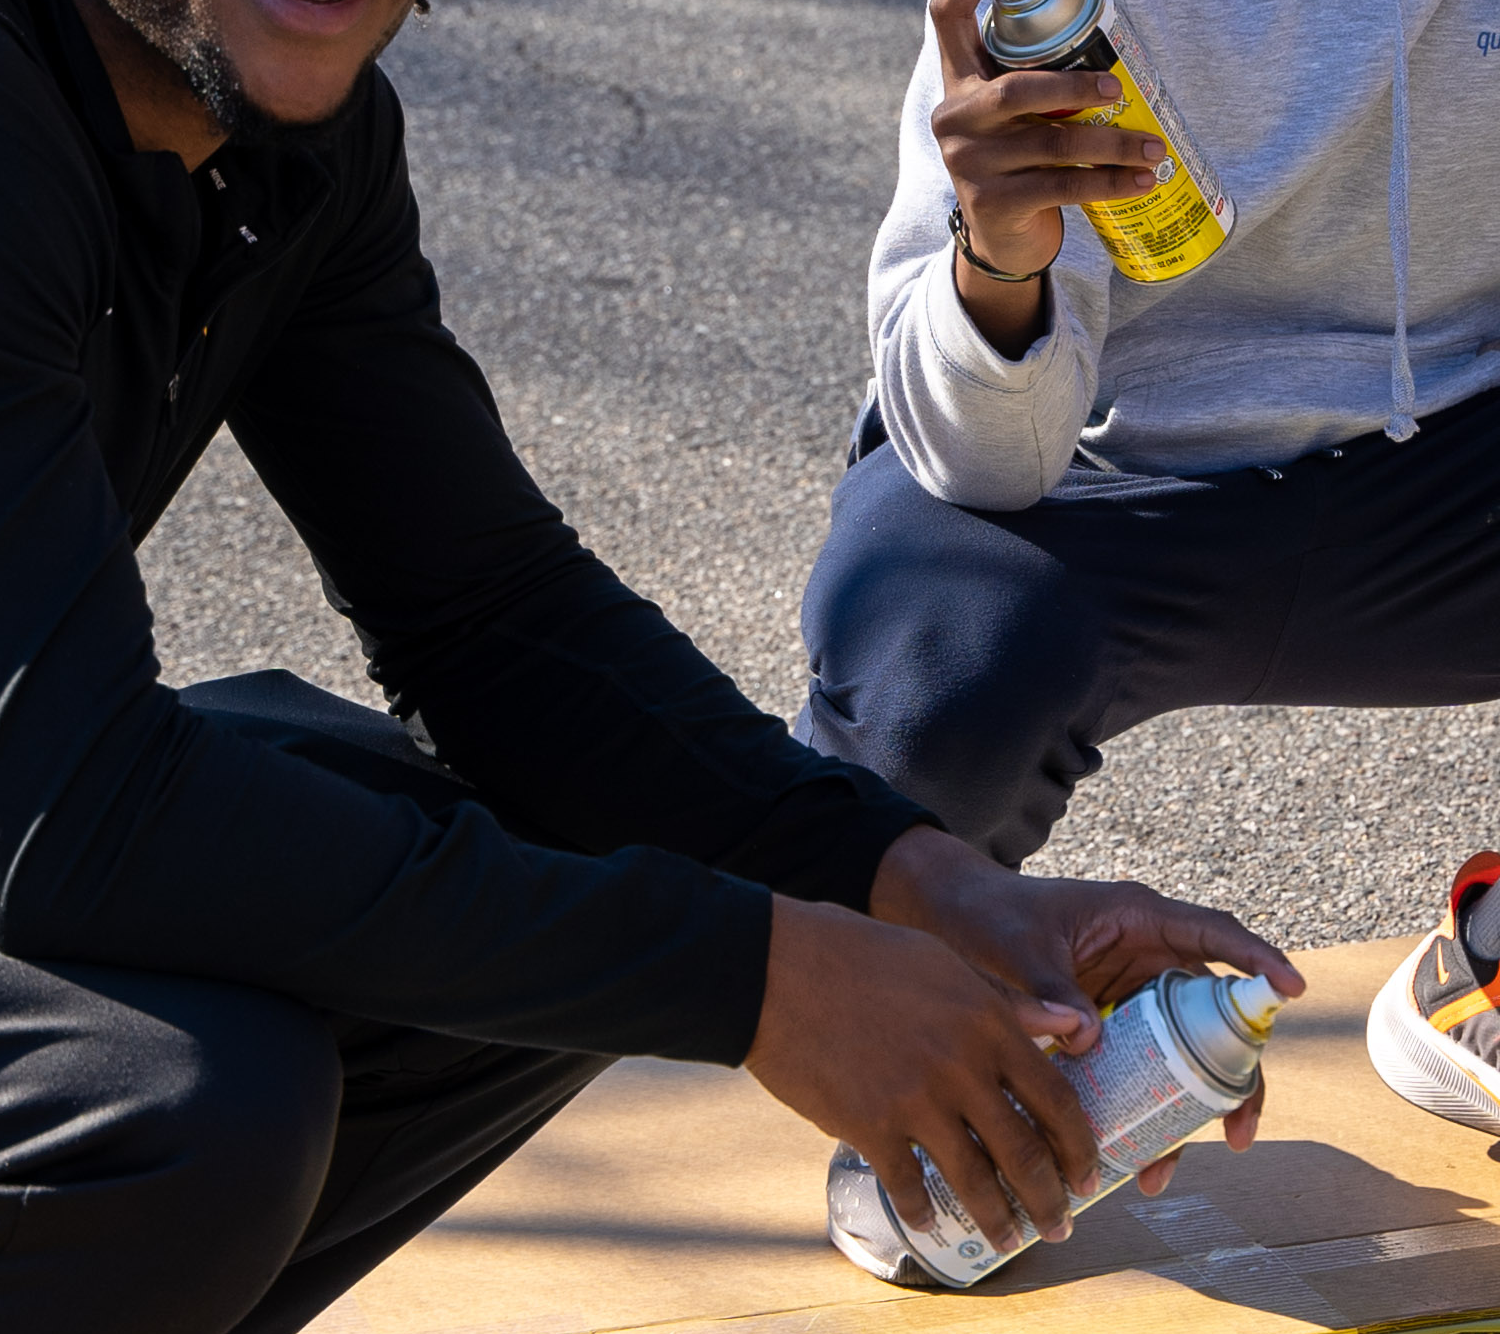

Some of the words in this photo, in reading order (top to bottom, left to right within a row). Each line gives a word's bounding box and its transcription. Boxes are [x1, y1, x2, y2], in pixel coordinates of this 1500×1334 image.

[209, 168, 227, 191] NIKE
[1110, 208, 1128, 216] SUN
[1127, 192, 1162, 213] YELLOW
[239, 225, 258, 244] NIKE
